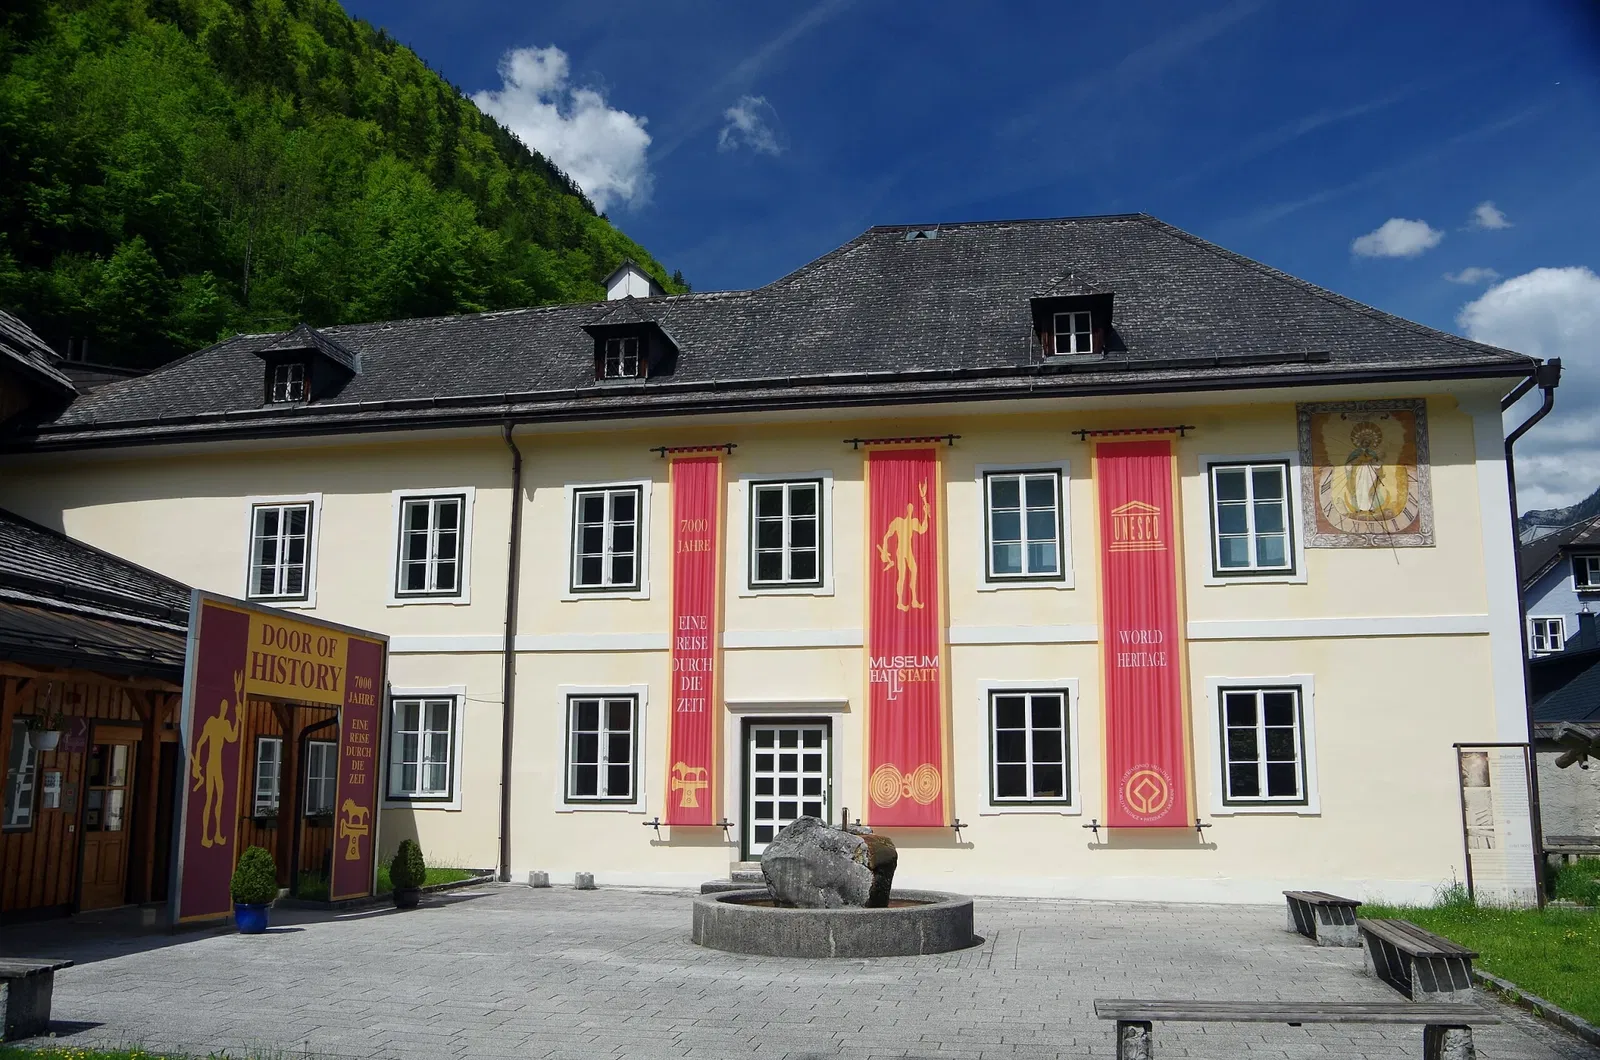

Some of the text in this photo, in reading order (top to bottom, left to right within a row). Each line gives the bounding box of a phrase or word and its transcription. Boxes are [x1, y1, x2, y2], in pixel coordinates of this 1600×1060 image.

[680, 519, 708, 533] 7000
[1114, 516, 1159, 540] UNESCO
[677, 539, 711, 554] JAHRE
[678, 615, 707, 630] EINE
[261, 623, 338, 659] DOOR OF
[676, 636, 708, 650] REISE
[1119, 629, 1163, 644] WORLD
[672, 658, 713, 672] DURCH
[869, 655, 939, 669] MUSEUM
[1117, 651, 1167, 668] HERITAGE
[250, 651, 343, 692] HISTORY
[354, 675, 372, 690] 7000
[681, 676, 703, 691] DIE
[869, 668, 937, 701] HALLSTATT
[348, 689, 375, 706] JAHRE
[676, 697, 705, 713] ZEIT
[352, 719, 369, 731] EINE
[349, 732, 370, 744] REISE
[346, 745, 372, 758] DURCH
[351, 759, 365, 771] DIE
[349, 773, 366, 784] ZEIT
